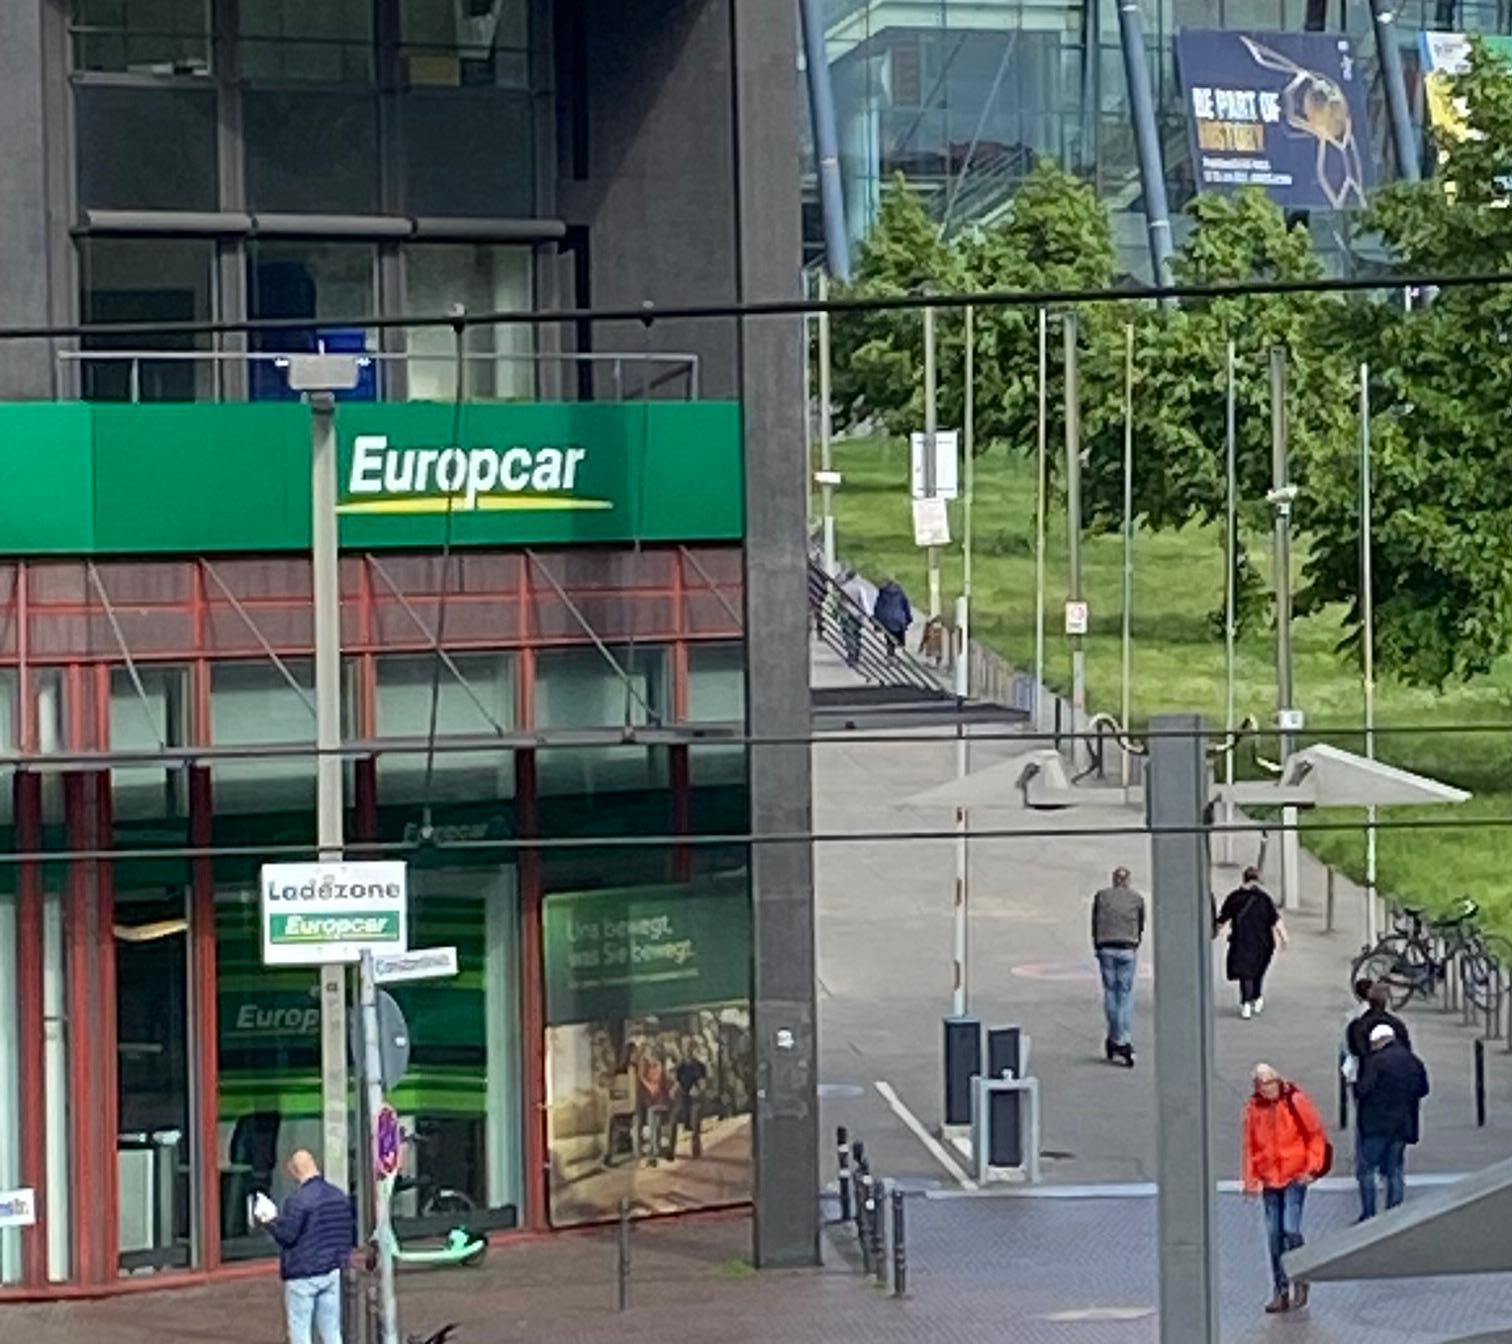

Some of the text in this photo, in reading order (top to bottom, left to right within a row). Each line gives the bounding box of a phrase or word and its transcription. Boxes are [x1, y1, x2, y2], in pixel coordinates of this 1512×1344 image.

[350, 436, 585, 510] Europcar
[268, 878, 400, 901] Ladezone
[284, 915, 389, 941] Europcar
